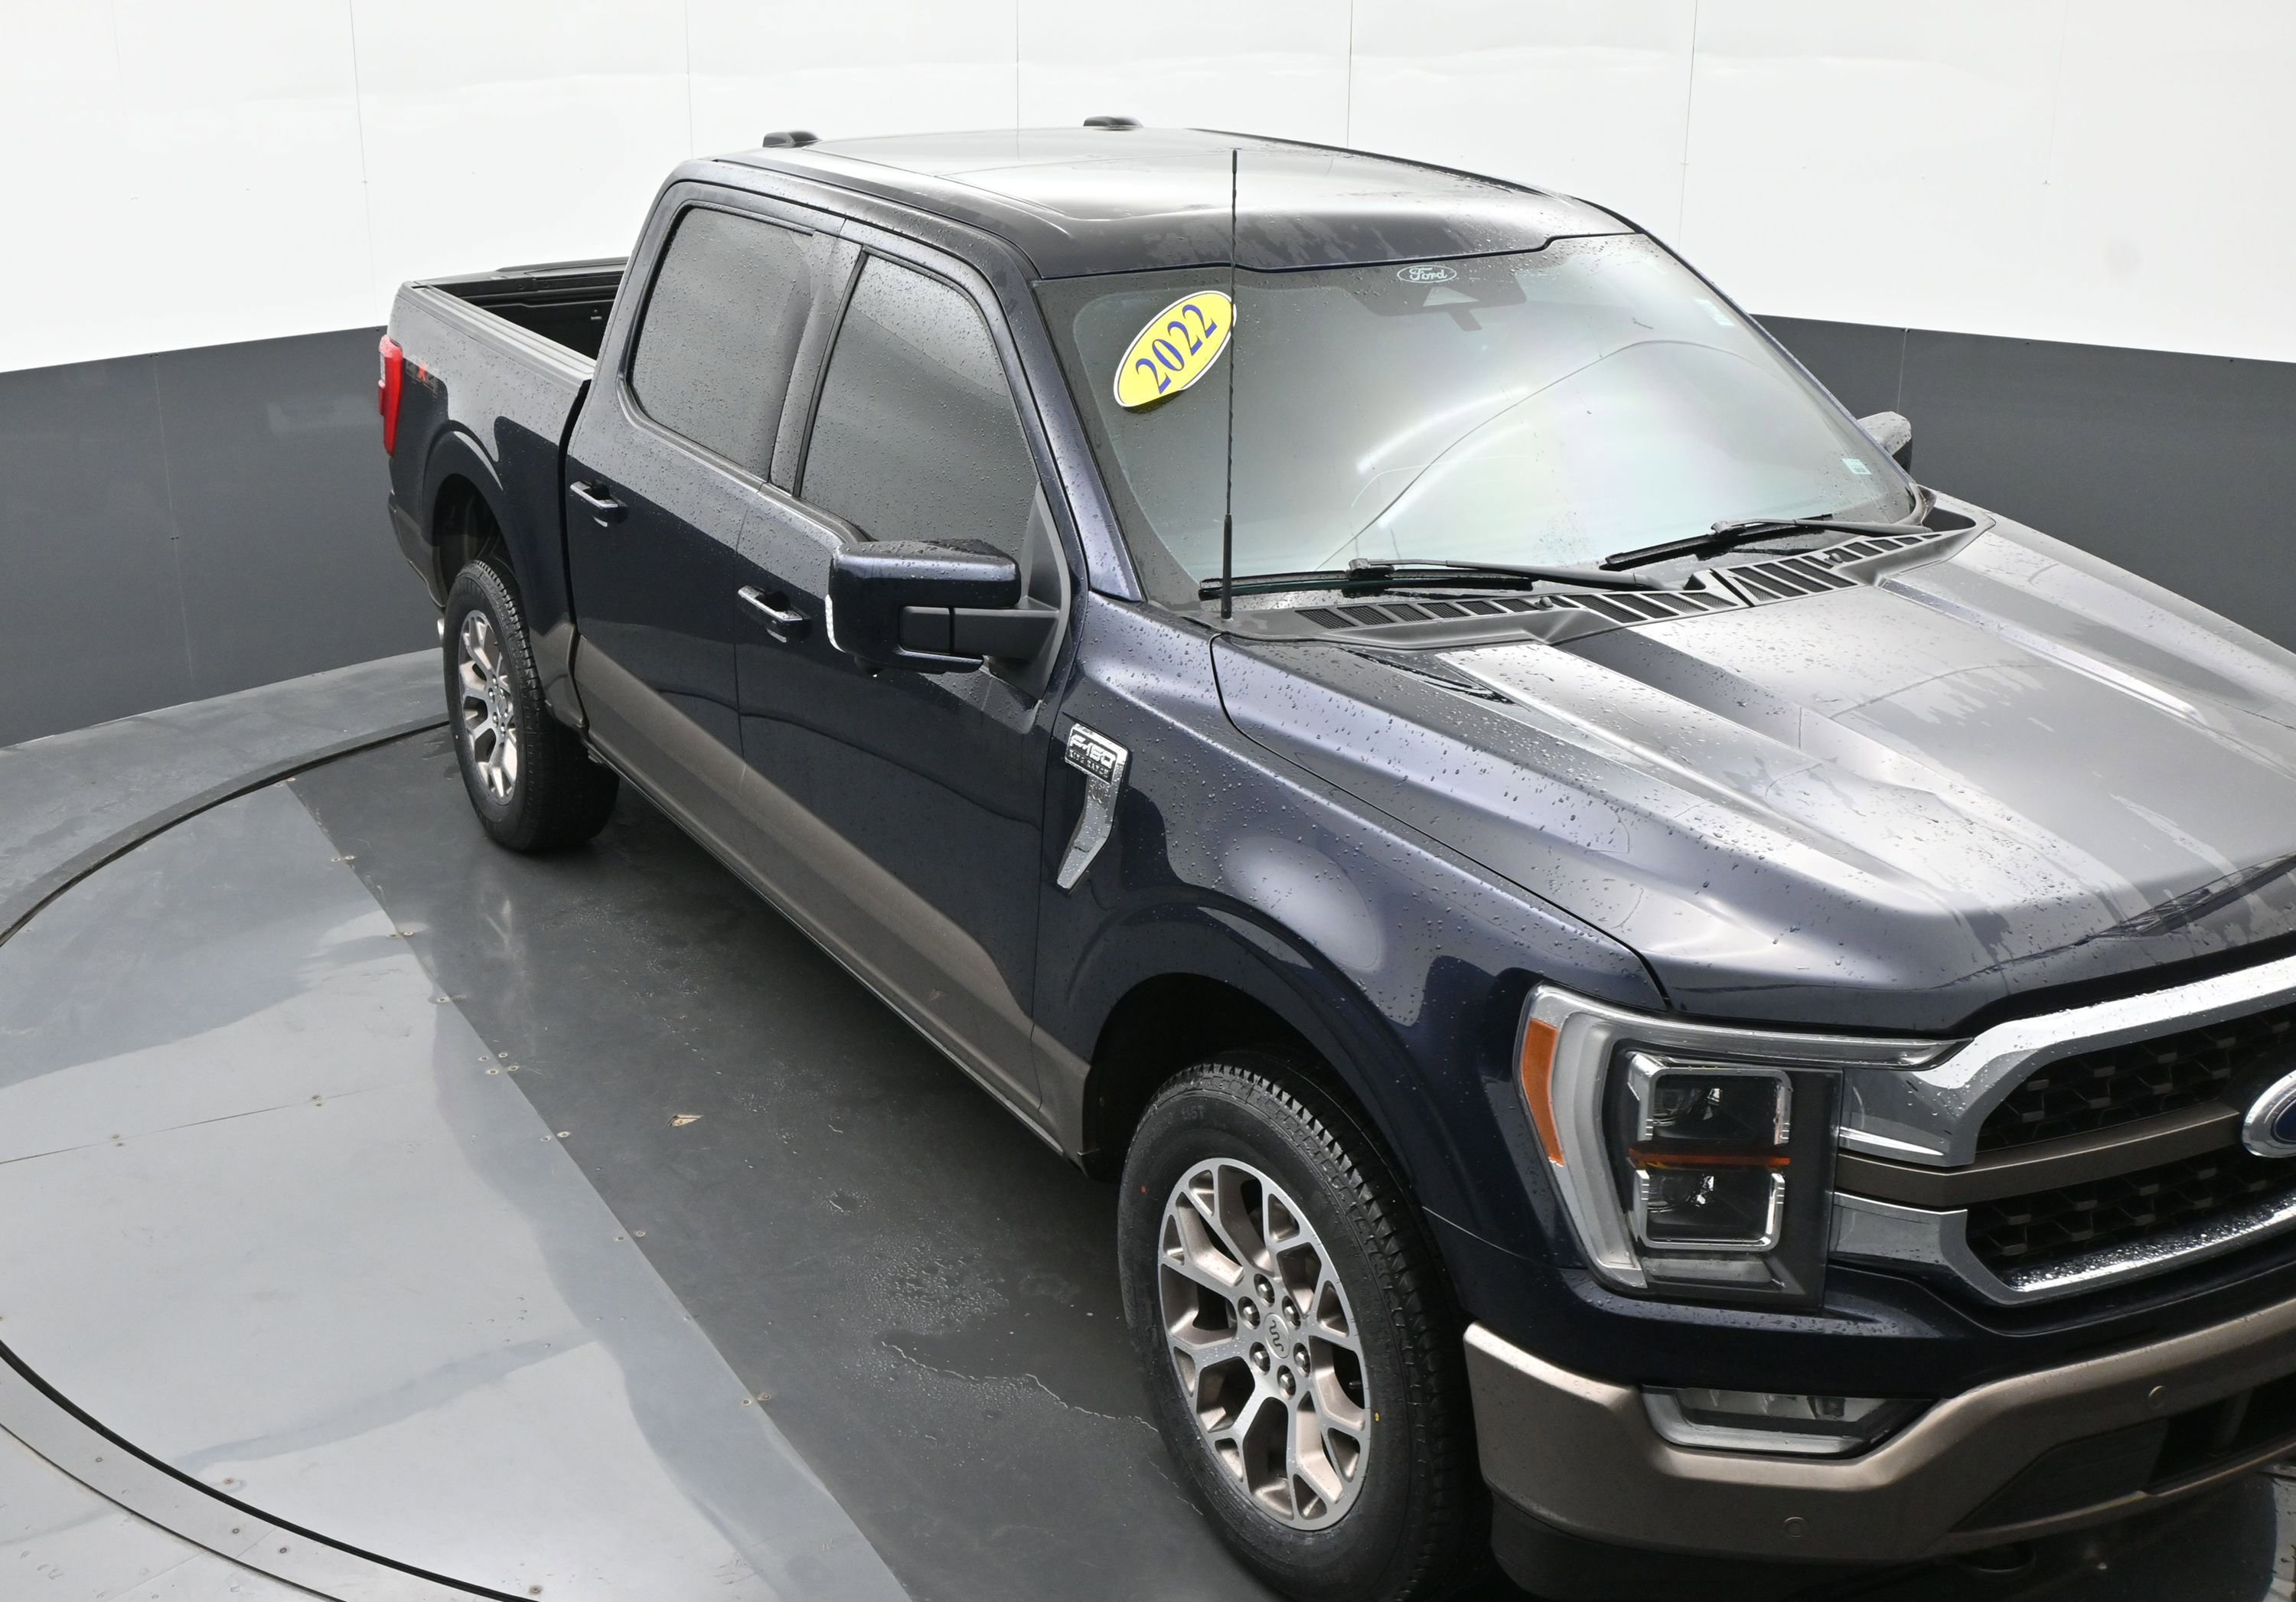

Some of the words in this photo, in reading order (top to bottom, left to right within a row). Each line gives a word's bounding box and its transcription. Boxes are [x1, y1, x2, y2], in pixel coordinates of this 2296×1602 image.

[1408, 267, 1448, 281] Ford
[1135, 304, 1218, 395] 2022
[1069, 733, 1117, 769] F-150
